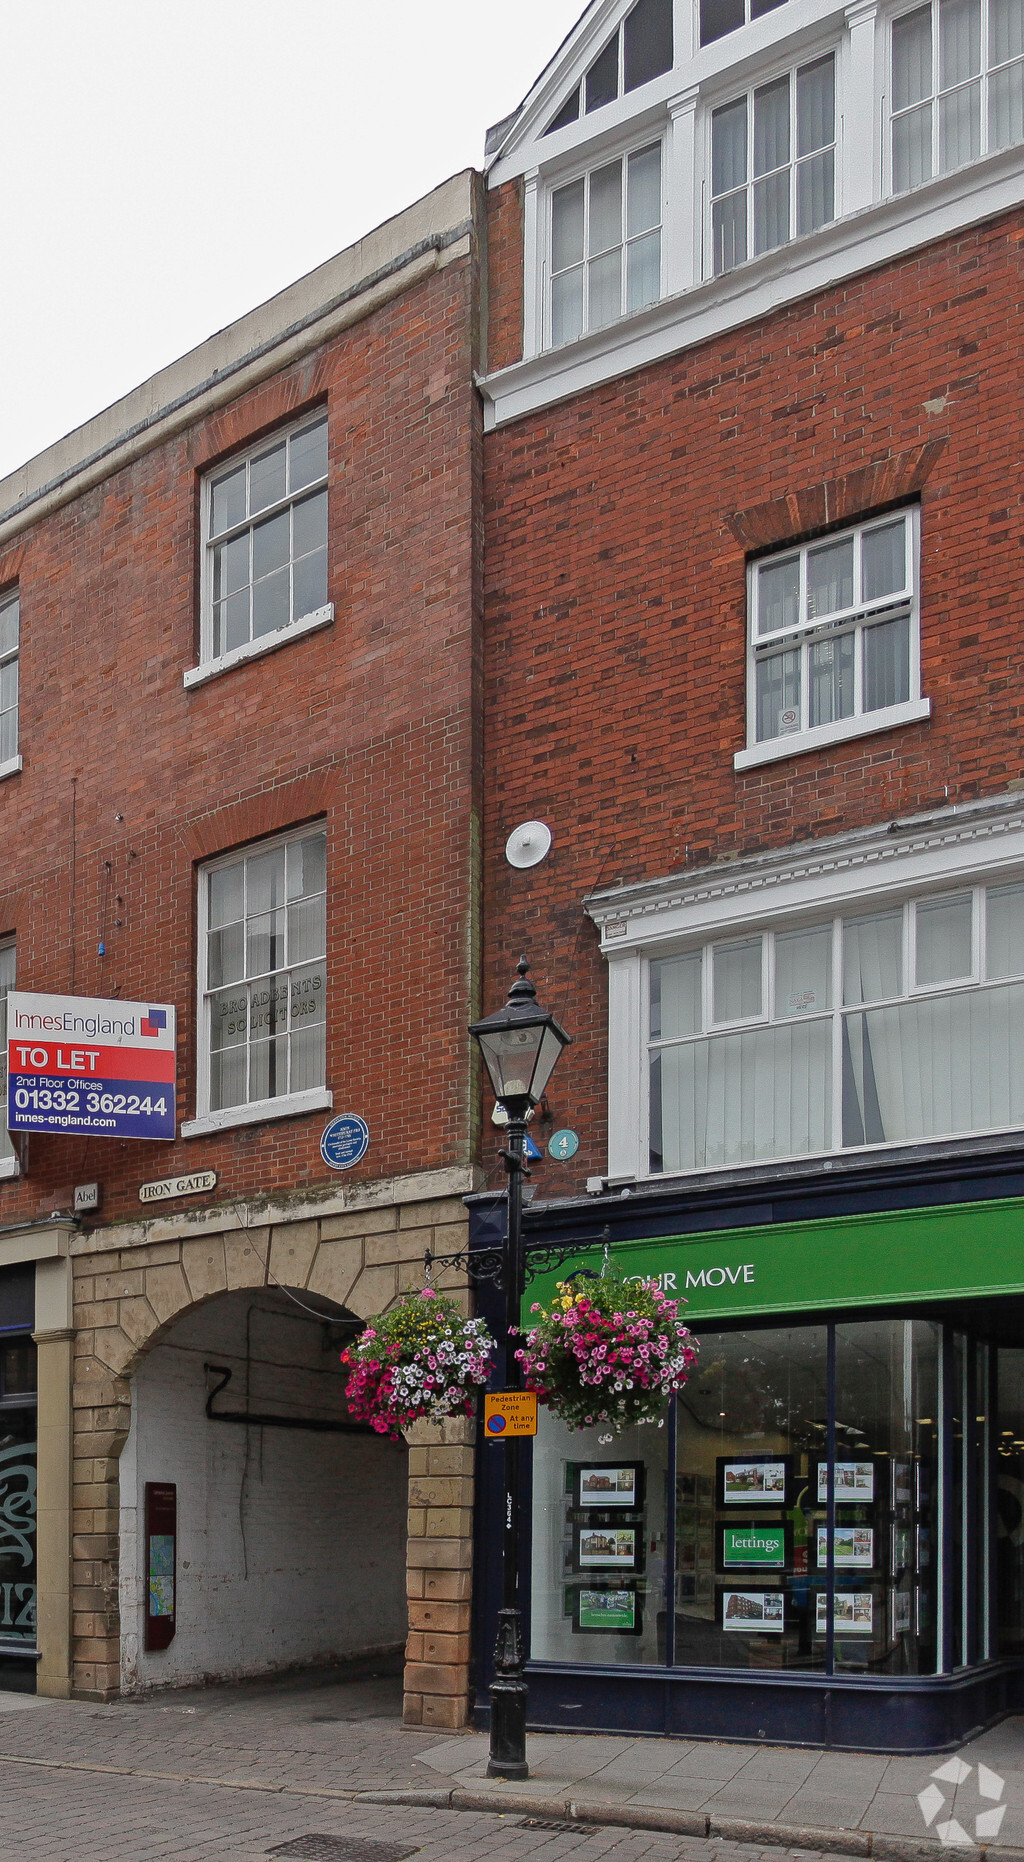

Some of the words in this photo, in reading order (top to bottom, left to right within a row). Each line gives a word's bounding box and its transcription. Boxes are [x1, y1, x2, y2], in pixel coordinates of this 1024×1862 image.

[219, 975, 322, 1016] BROADBENTS
[15, 1009, 135, 1038] InnesEngland
[16, 1046, 49, 1068] TO
[56, 1049, 101, 1071] LET
[16, 1075, 36, 1087] 2nd
[39, 1077, 65, 1089] Floor
[67, 1078, 103, 1091] Offices
[15, 1088, 80, 1111] 01332
[86, 1092, 167, 1116] 362244
[15, 1111, 117, 1128] innes-england.com
[558, 1136, 569, 1148] 4
[76, 1188, 96, 1203] Abel
[143, 1182, 173, 1199] IRON
[176, 1174, 211, 1191] GATE
[622, 1271, 678, 1292] OUR
[685, 1264, 755, 1288] MOVE
[490, 1395, 531, 1403] Pedestrian
[731, 1534, 780, 1553] lettings
